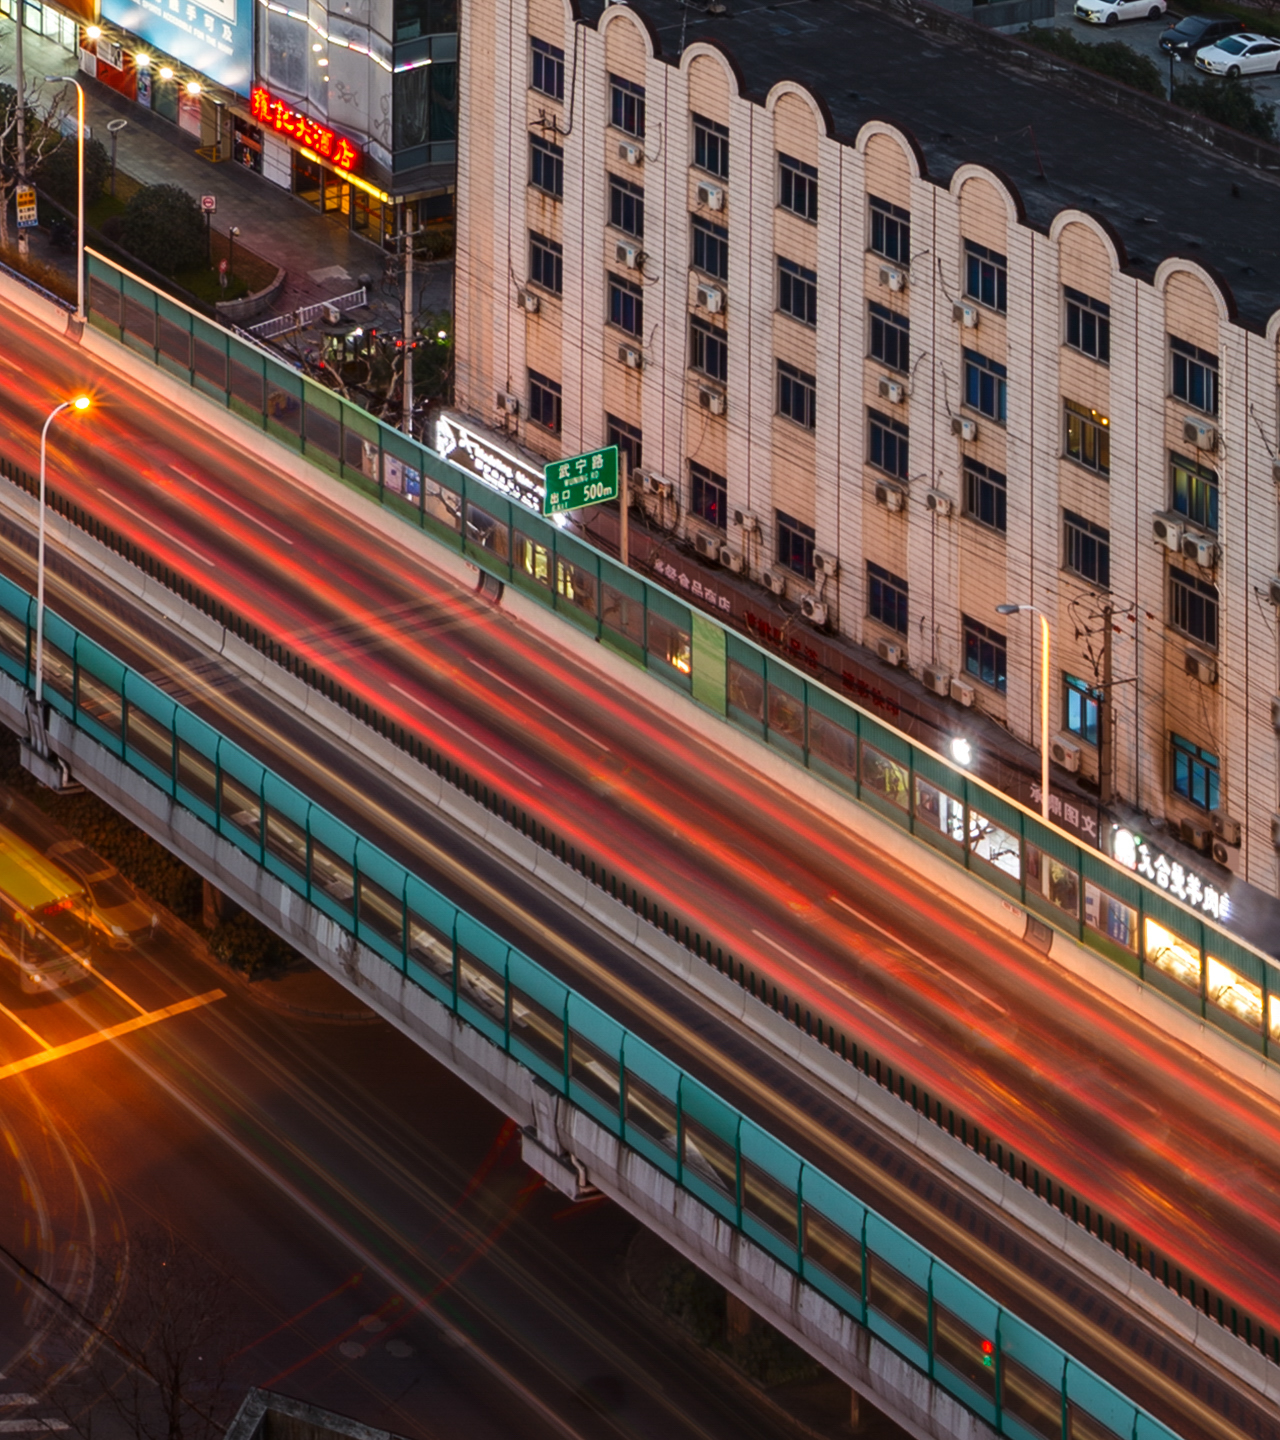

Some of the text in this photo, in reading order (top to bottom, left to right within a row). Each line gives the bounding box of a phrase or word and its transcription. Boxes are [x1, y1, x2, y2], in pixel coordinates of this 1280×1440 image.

[558, 453, 604, 480] 武宁路
[550, 482, 613, 505] 出口 500m
